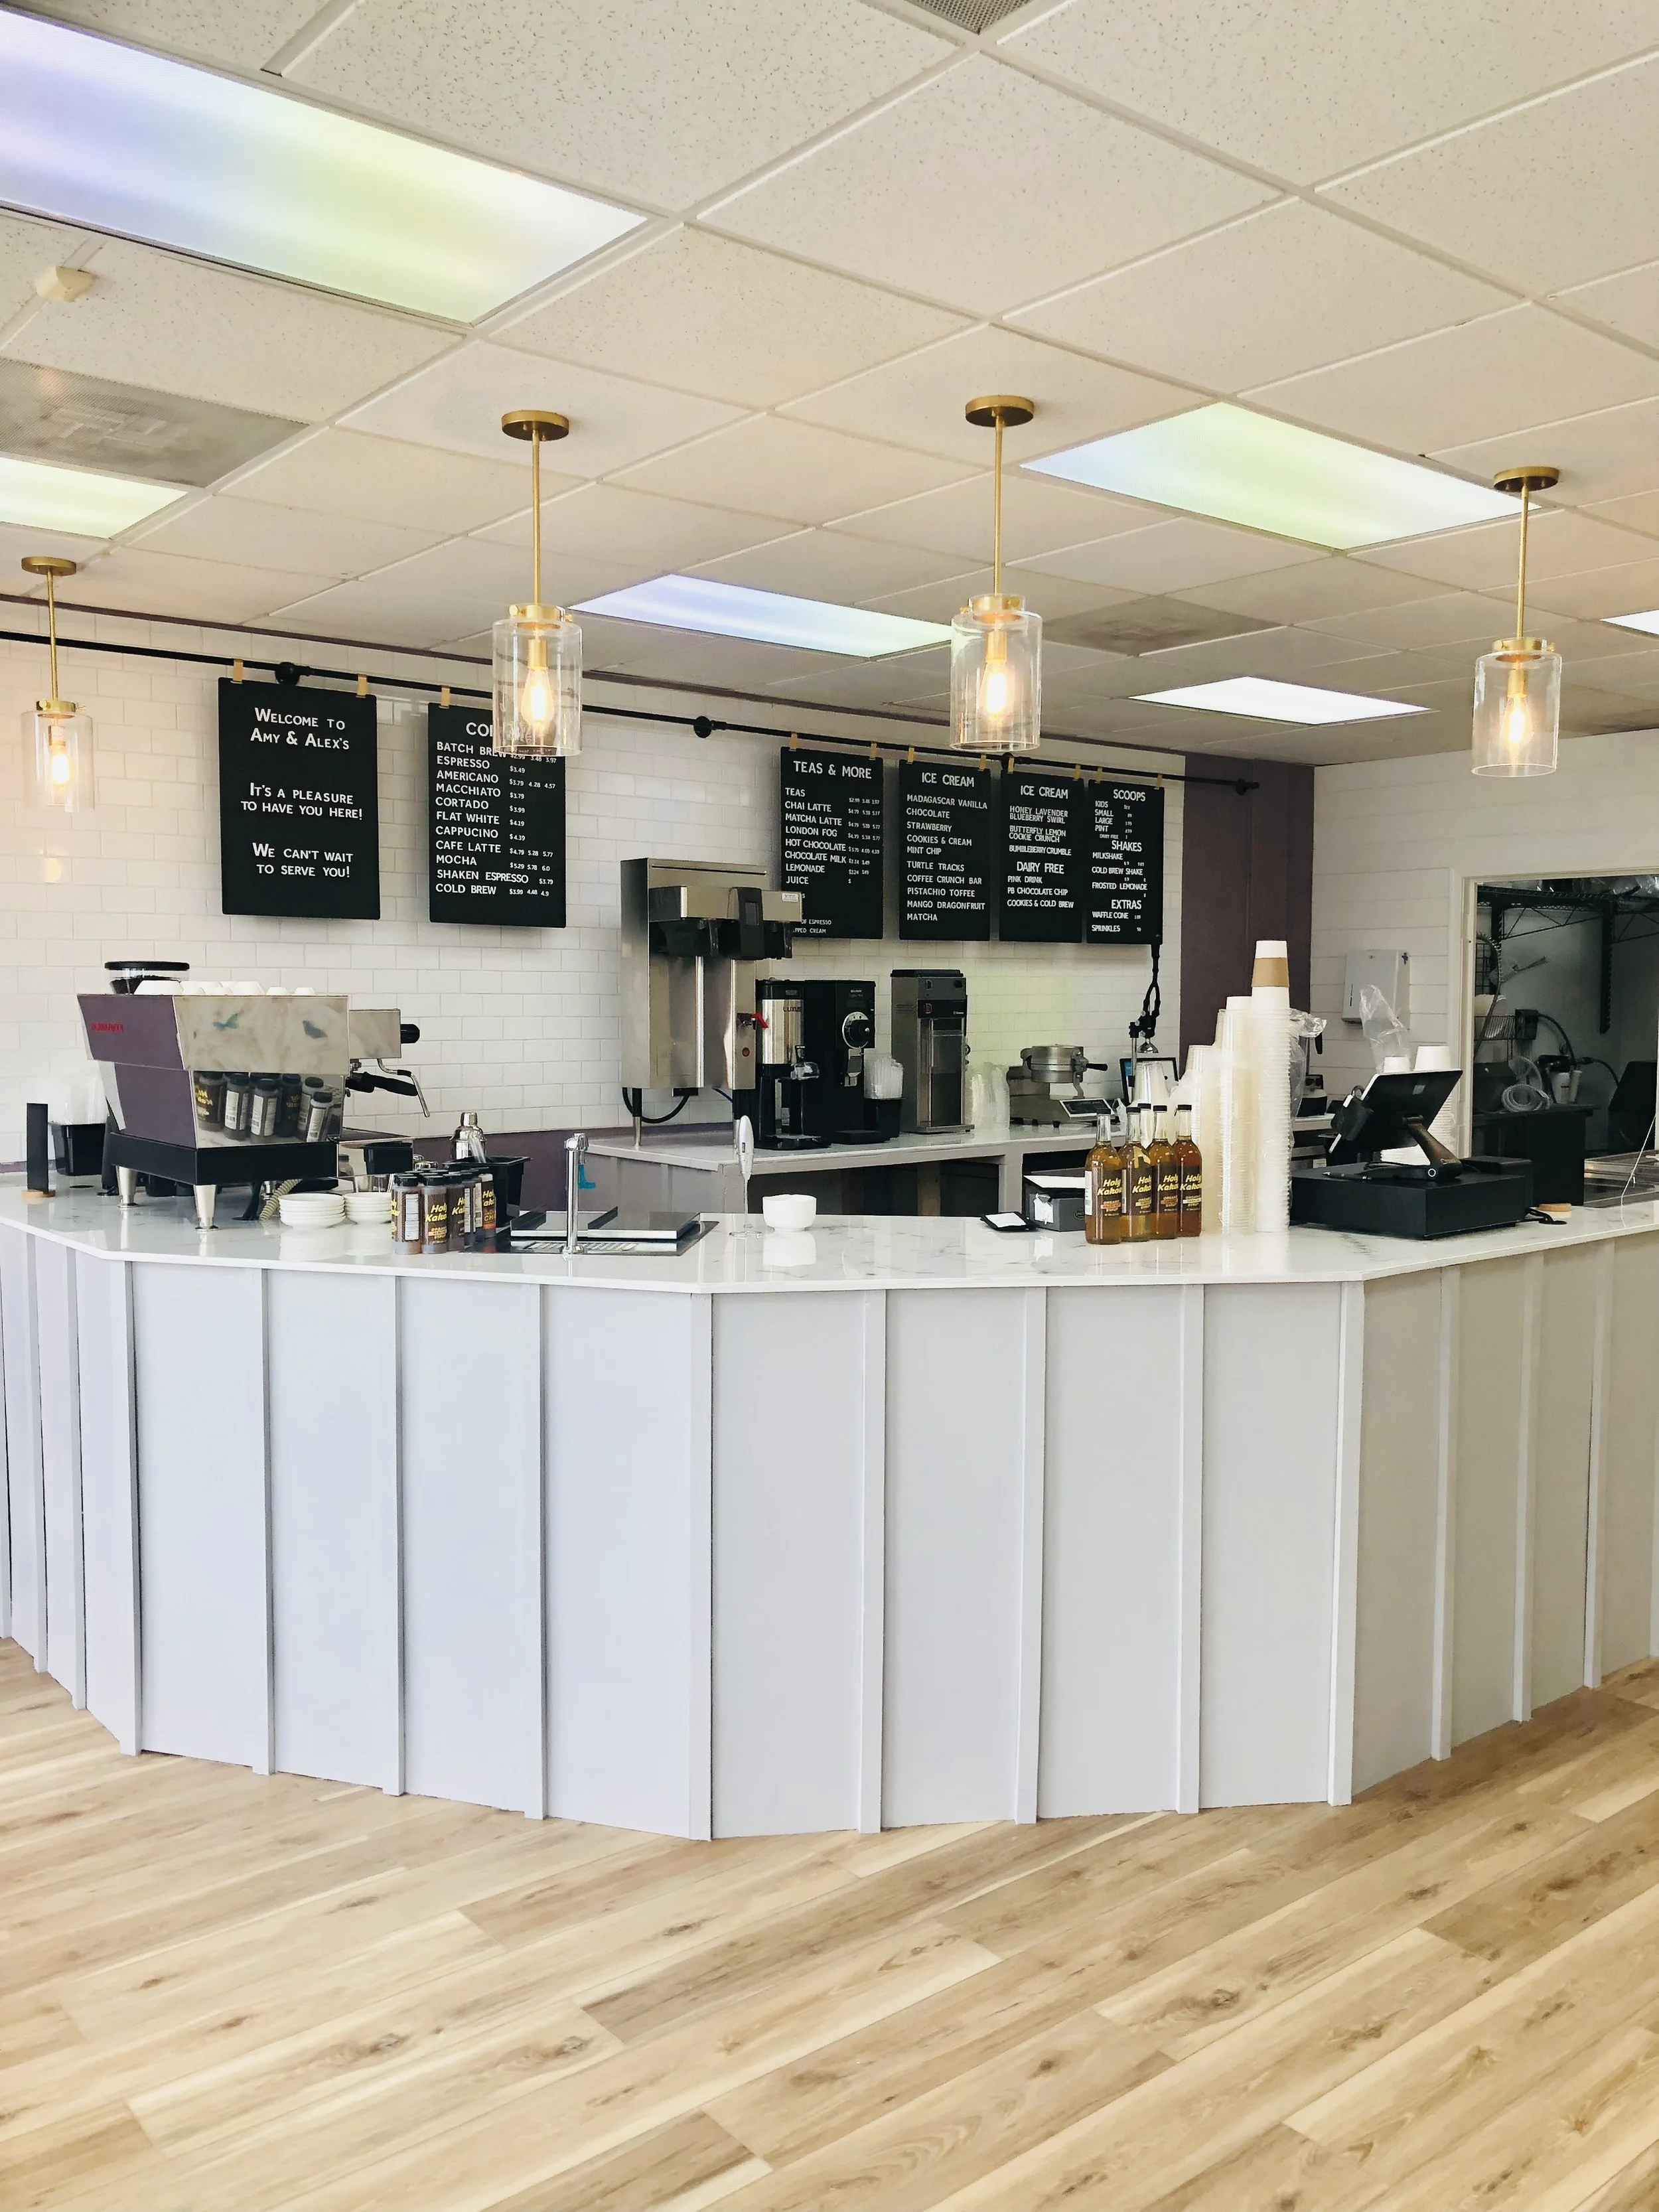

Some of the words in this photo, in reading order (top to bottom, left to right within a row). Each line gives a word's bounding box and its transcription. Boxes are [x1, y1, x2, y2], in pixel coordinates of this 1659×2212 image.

[255, 707, 319, 727] WELCOME
[326, 719, 345, 730] TO
[250, 728, 280, 743] AMY
[286, 731, 297, 745] &
[305, 733, 349, 749] ALEX'S
[437, 741, 474, 754] BATCH
[437, 755, 490, 769] ESPRESSO
[793, 761, 823, 774] TEAS
[828, 764, 835, 775] &
[842, 766, 871, 778] MORE
[437, 770, 498, 783] AMERICANO
[922, 773, 937, 783] ICE
[942, 774, 974, 787] CREAM
[250, 782, 271, 797] IT'S
[277, 788, 285, 798] A
[293, 790, 353, 804] PLEASURE
[437, 783, 500, 797] MACCHIATO
[785, 788, 805, 796] TEAS
[1021, 785, 1035, 796] ICE
[1039, 786, 1068, 799] CREAM
[1114, 789, 1145, 802] SCOOPS
[435, 797, 488, 809] CORTADO
[785, 801, 804, 810] CHAI
[808, 802, 831, 812] LATTE
[907, 794, 955, 806] MADAGASCAR
[958, 799, 987, 809] VANILLA
[241, 801, 257, 811] TO
[262, 802, 293, 814] HAVE
[299, 805, 323, 816] YOU
[329, 808, 362, 820] HERE!
[906, 808, 950, 818] CHOCOLATE
[1009, 806, 1033, 814] HONEY
[1035, 808, 1068, 817] LAVENDER
[437, 811, 462, 821] FLAT
[466, 813, 500, 824] WHITE
[786, 813, 816, 823] MATCHA
[820, 816, 842, 826] LATTE
[1009, 813, 1043, 822] BLUEBERRY
[435, 826, 498, 838] CAPPUCINO
[786, 826, 819, 836] LONDON
[907, 821, 952, 832] STRAWBERRY
[1009, 826, 1043, 834] BUTTERFLY
[1045, 828, 1066, 837] LEMON
[906, 834, 938, 844] COOKIES
[948, 838, 972, 846] CREAM
[1009, 832, 1032, 841] COOKIE
[436, 840, 463, 850] CAFE
[469, 842, 501, 853] LATTE
[803, 840, 846, 851] CHOCOLATE
[1009, 845, 1046, 853] BUMBLEBERRY
[1046, 847, 1072, 856] CRUMBLE
[1112, 840, 1142, 851] SHAKES
[252, 842, 275, 857] WE
[283, 848, 319, 859] CAN'T
[324, 851, 354, 862] WAIT
[785, 851, 828, 861] CHOCOLATE
[830, 855, 846, 863] MILK
[437, 855, 477, 865] MOCHA
[906, 861, 933, 869] TURTLE
[938, 863, 964, 871] TRACKS
[256, 864, 274, 874] TO
[281, 865, 315, 876] SERVE
[323, 866, 350, 877] YOU!
[786, 863, 825, 873] LEMONADE
[1017, 861, 1041, 872] DAIRY
[1045, 863, 1064, 874] FREE
[437, 869, 478, 879] SHAKEN
[486, 872, 528, 883] ESPRESSO
[435, 883, 465, 893] COLD
[471, 885, 496, 895] BREW
[937, 901, 985, 910] DRAGONFRUIT
[1112, 899, 1141, 909] EXTRAS
[1103, 1178, 1121, 1187] Holy
[1185, 1173, 1202, 1183] Holy
